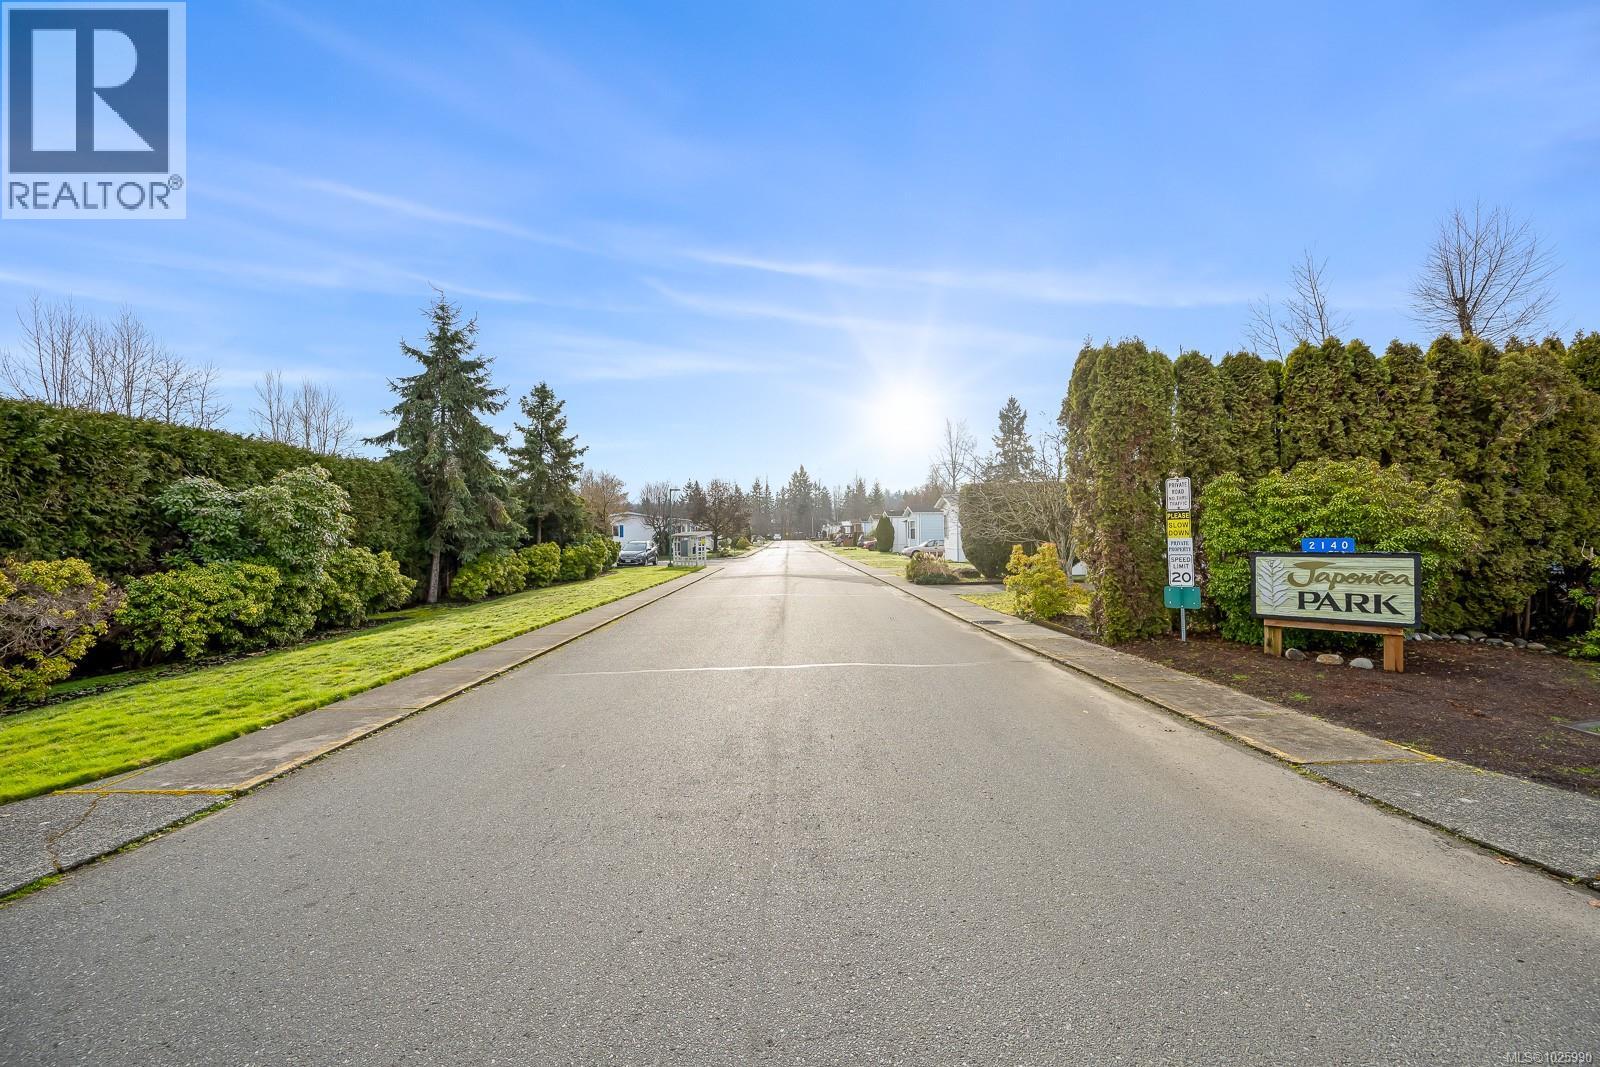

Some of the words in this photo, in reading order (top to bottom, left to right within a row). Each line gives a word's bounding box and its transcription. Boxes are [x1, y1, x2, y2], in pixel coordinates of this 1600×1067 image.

[1309, 541, 1348, 550] 2140
[1171, 572, 1192, 583] 20
[1287, 561, 1415, 590] Japonica
[1297, 591, 1405, 616] PARK
